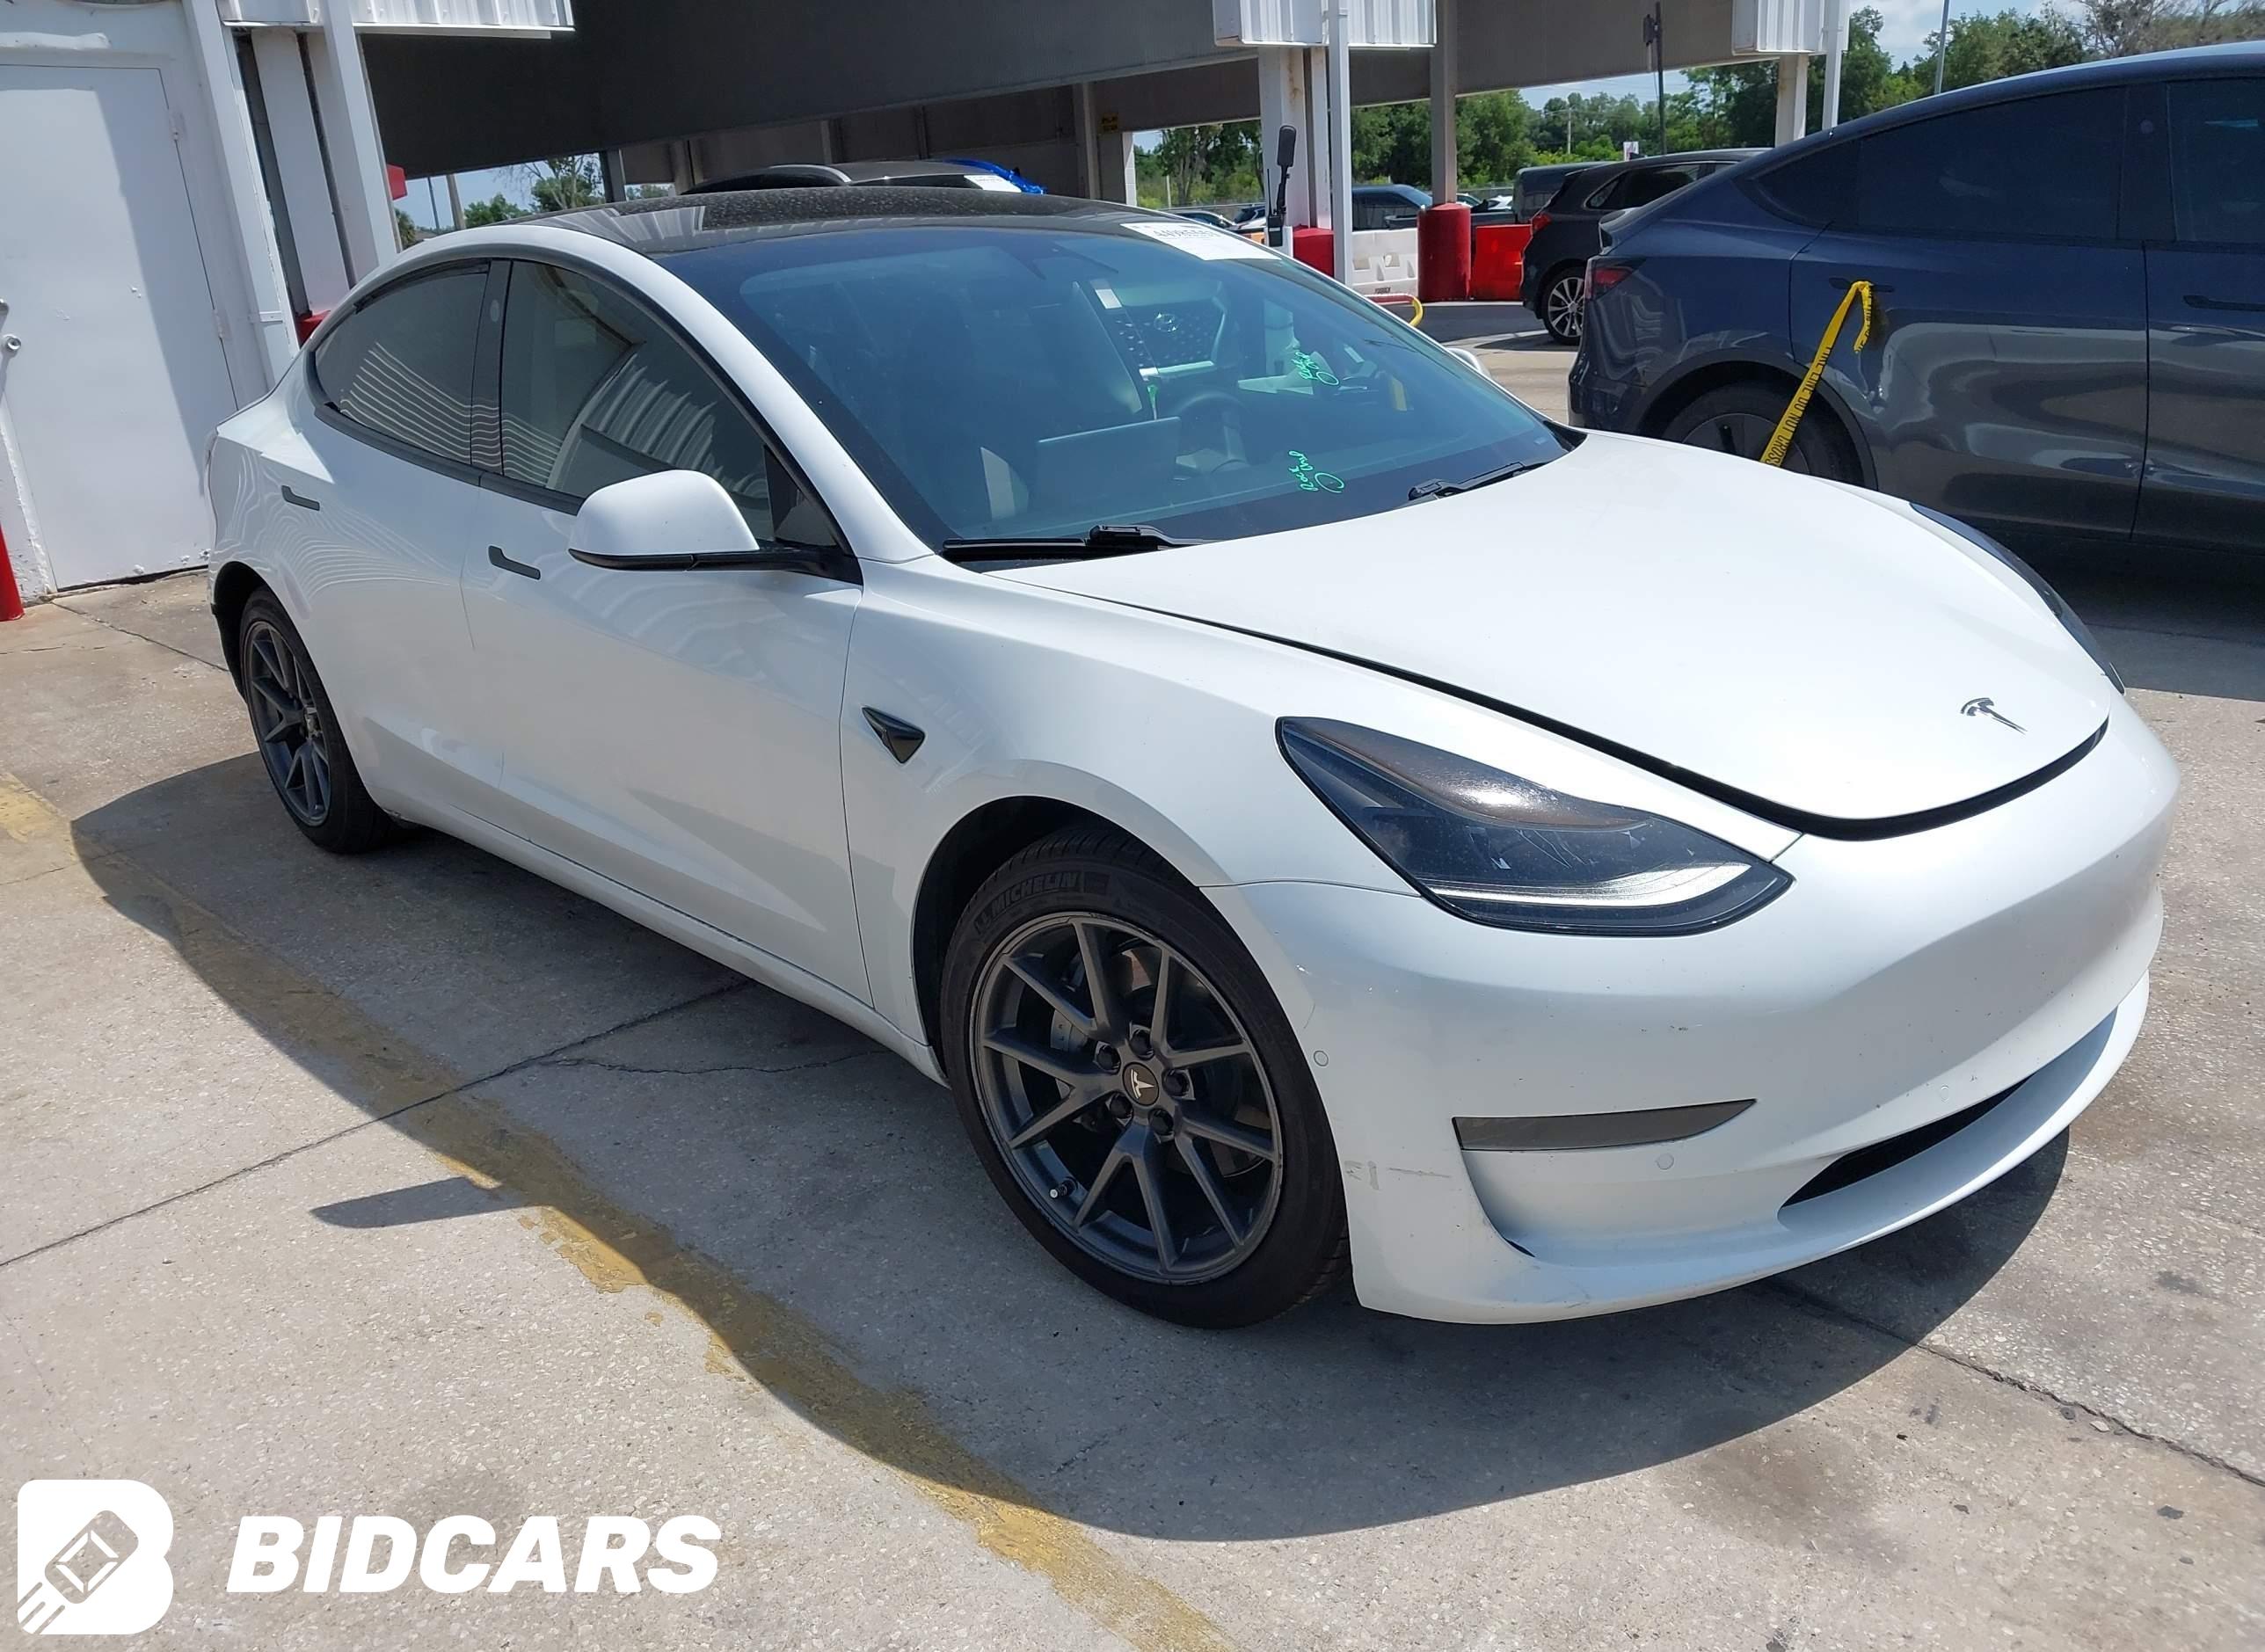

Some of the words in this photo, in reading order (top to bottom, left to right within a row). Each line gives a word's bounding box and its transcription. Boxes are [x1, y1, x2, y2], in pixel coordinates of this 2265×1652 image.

[1794, 397, 1810, 411] DO
[1783, 411, 1802, 433] NOT
[991, 871, 1080, 917] MICHELIN
